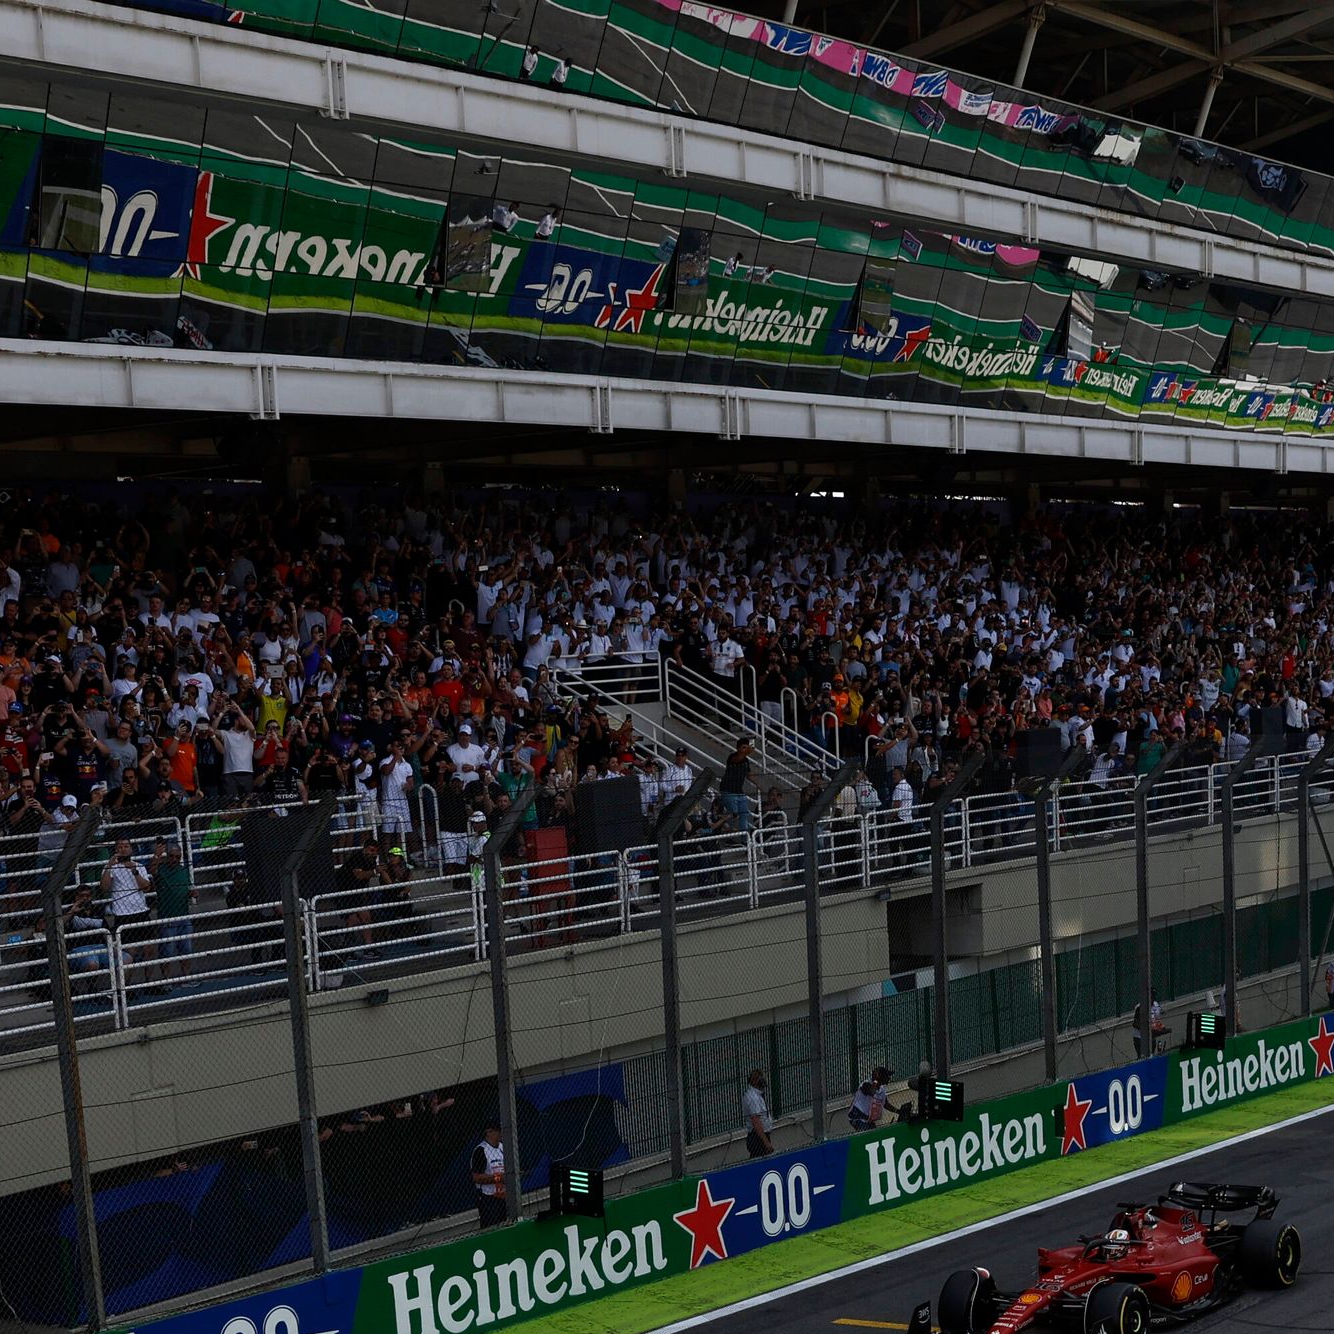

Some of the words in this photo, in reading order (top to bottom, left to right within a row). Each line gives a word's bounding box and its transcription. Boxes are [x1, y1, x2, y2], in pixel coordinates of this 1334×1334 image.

[1179, 1038, 1307, 1113] Heineken
[865, 1107, 1047, 1206] Heineken
[1108, 1074, 1143, 1135] 0.0
[759, 1162, 813, 1238] 0.0
